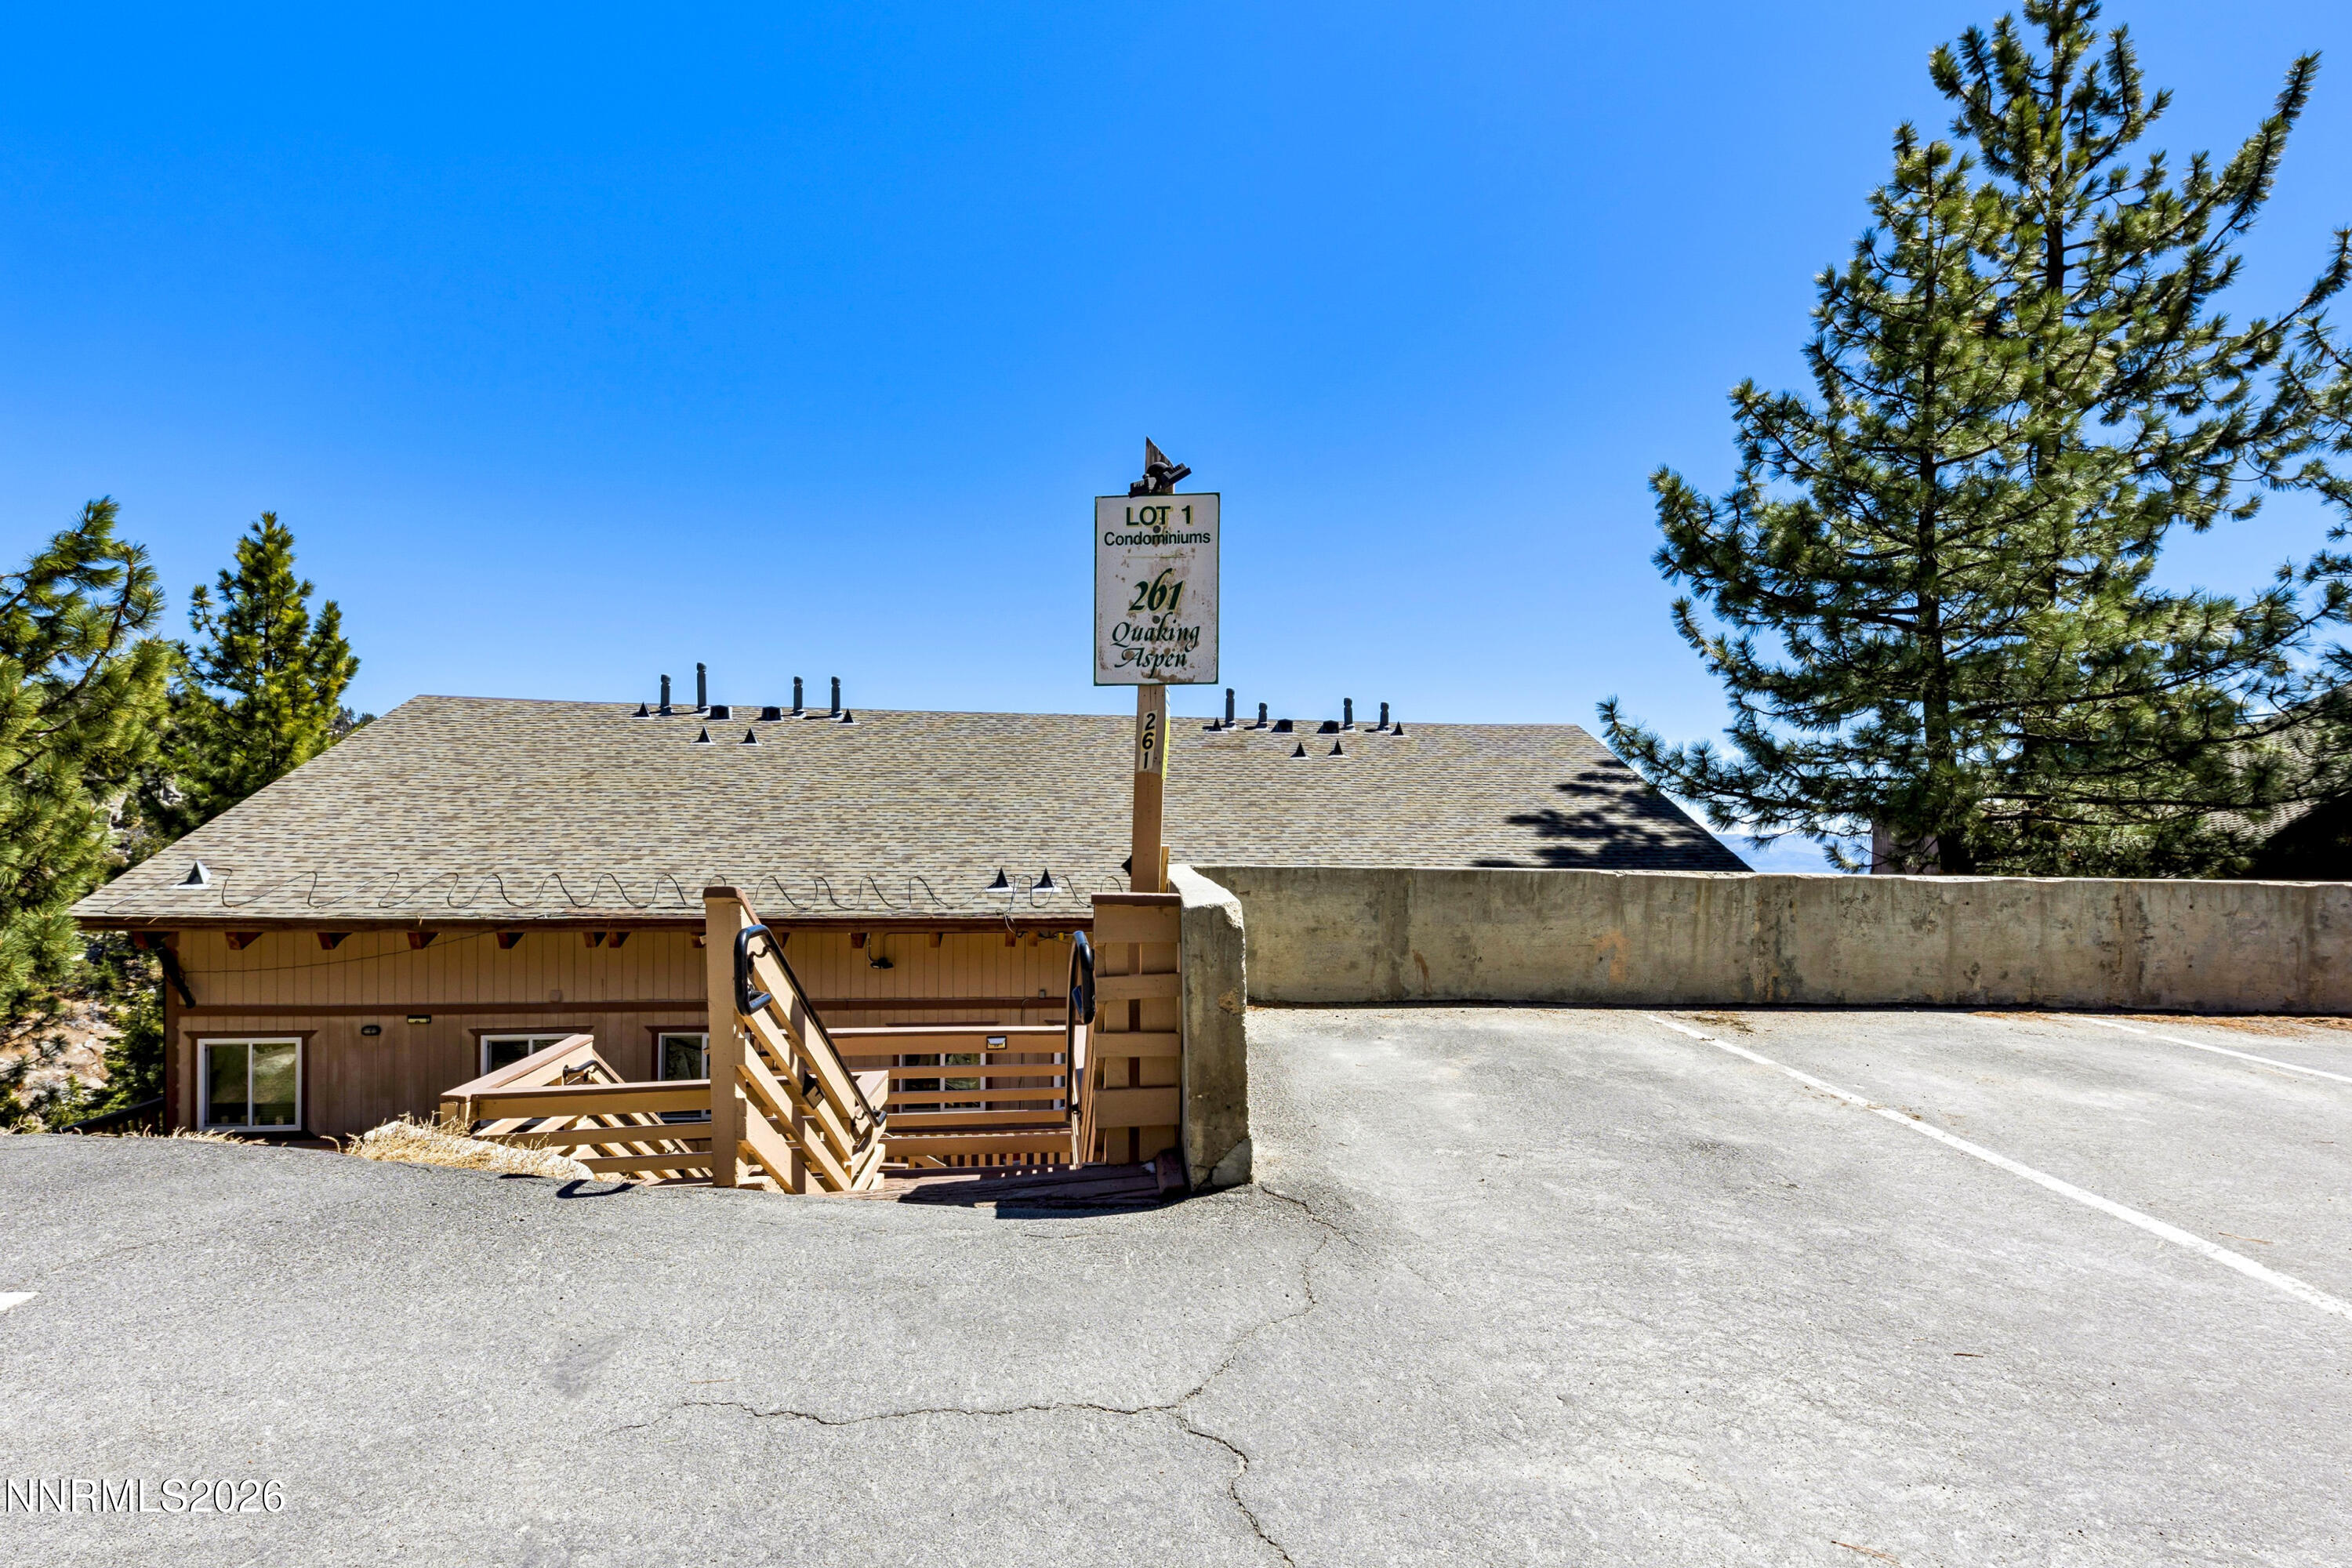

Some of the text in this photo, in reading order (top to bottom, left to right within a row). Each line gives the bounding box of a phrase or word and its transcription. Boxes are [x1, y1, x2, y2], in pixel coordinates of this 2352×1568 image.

[1126, 505, 1193, 527] LOT 1
[1104, 531, 1210, 546] Condominiums
[1128, 568, 1185, 612] 261
[1110, 612, 1200, 652] Quaking
[1114, 648, 1187, 678] Aspen
[1142, 713, 1156, 769] 261
